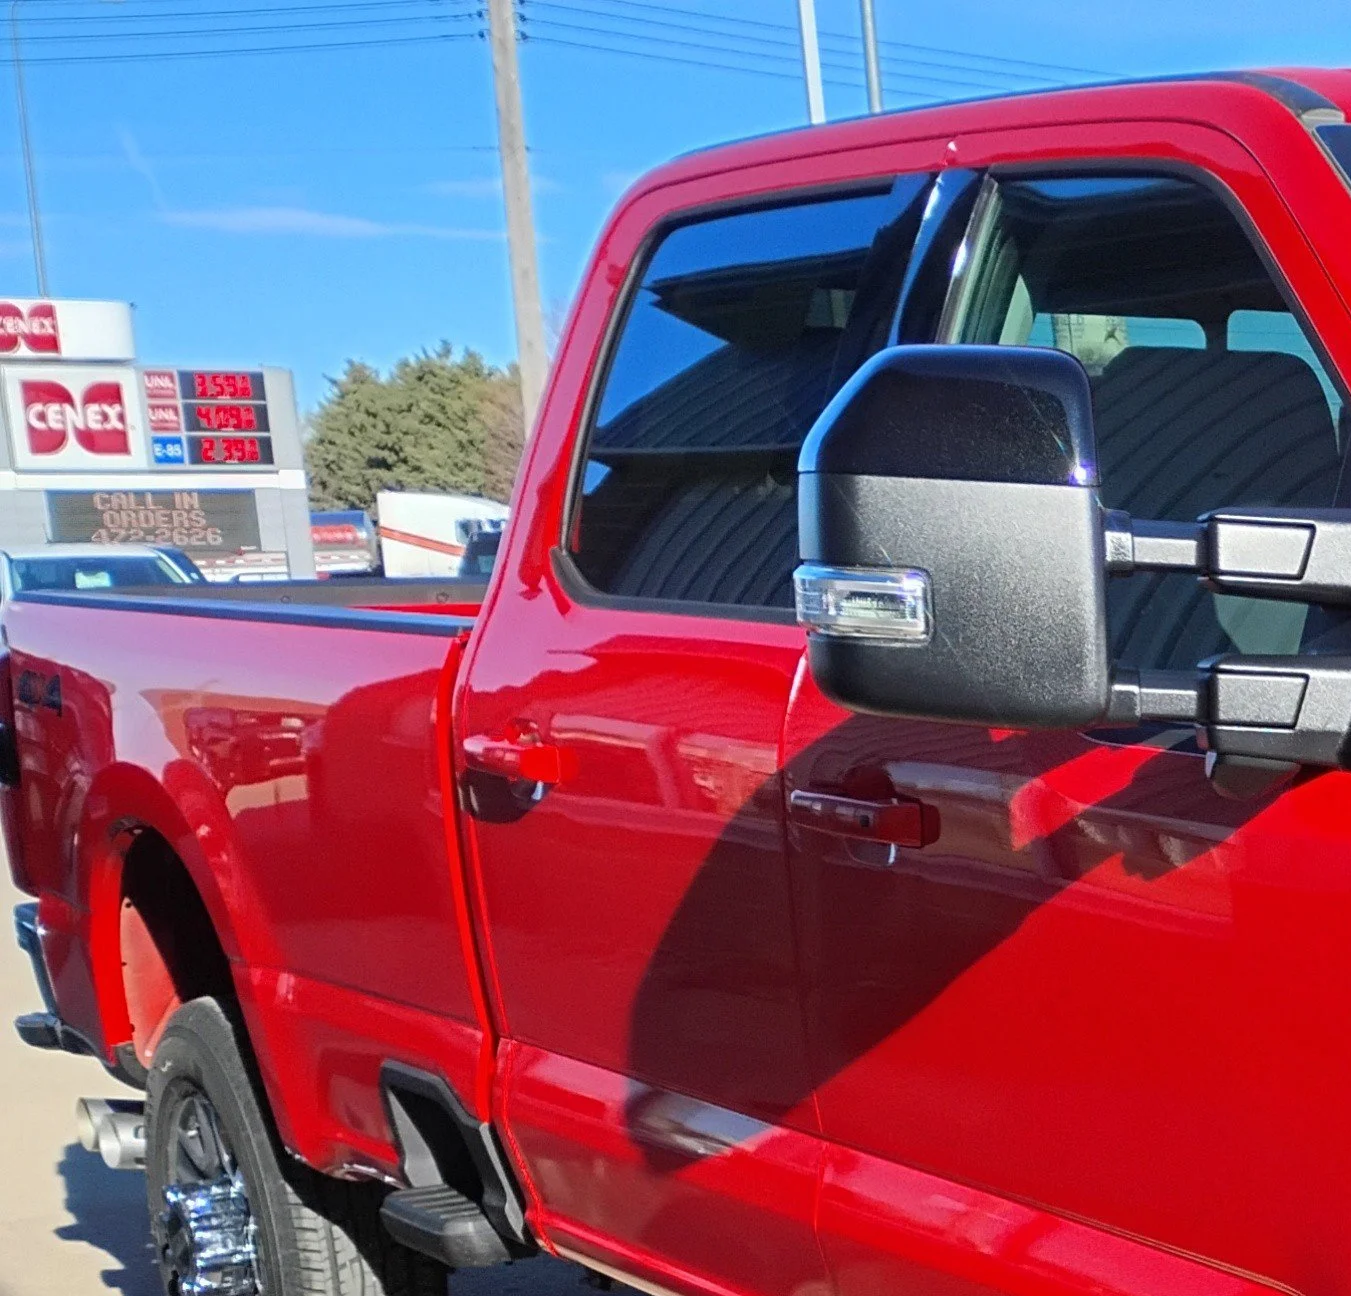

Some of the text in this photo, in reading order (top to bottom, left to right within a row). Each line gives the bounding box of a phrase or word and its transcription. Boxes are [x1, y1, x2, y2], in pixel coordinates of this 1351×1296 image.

[0, 316, 55, 335] ENEX
[27, 402, 125, 431] CENEX
[93, 492, 199, 510] CALL IN
[103, 510, 207, 528] ORDERS
